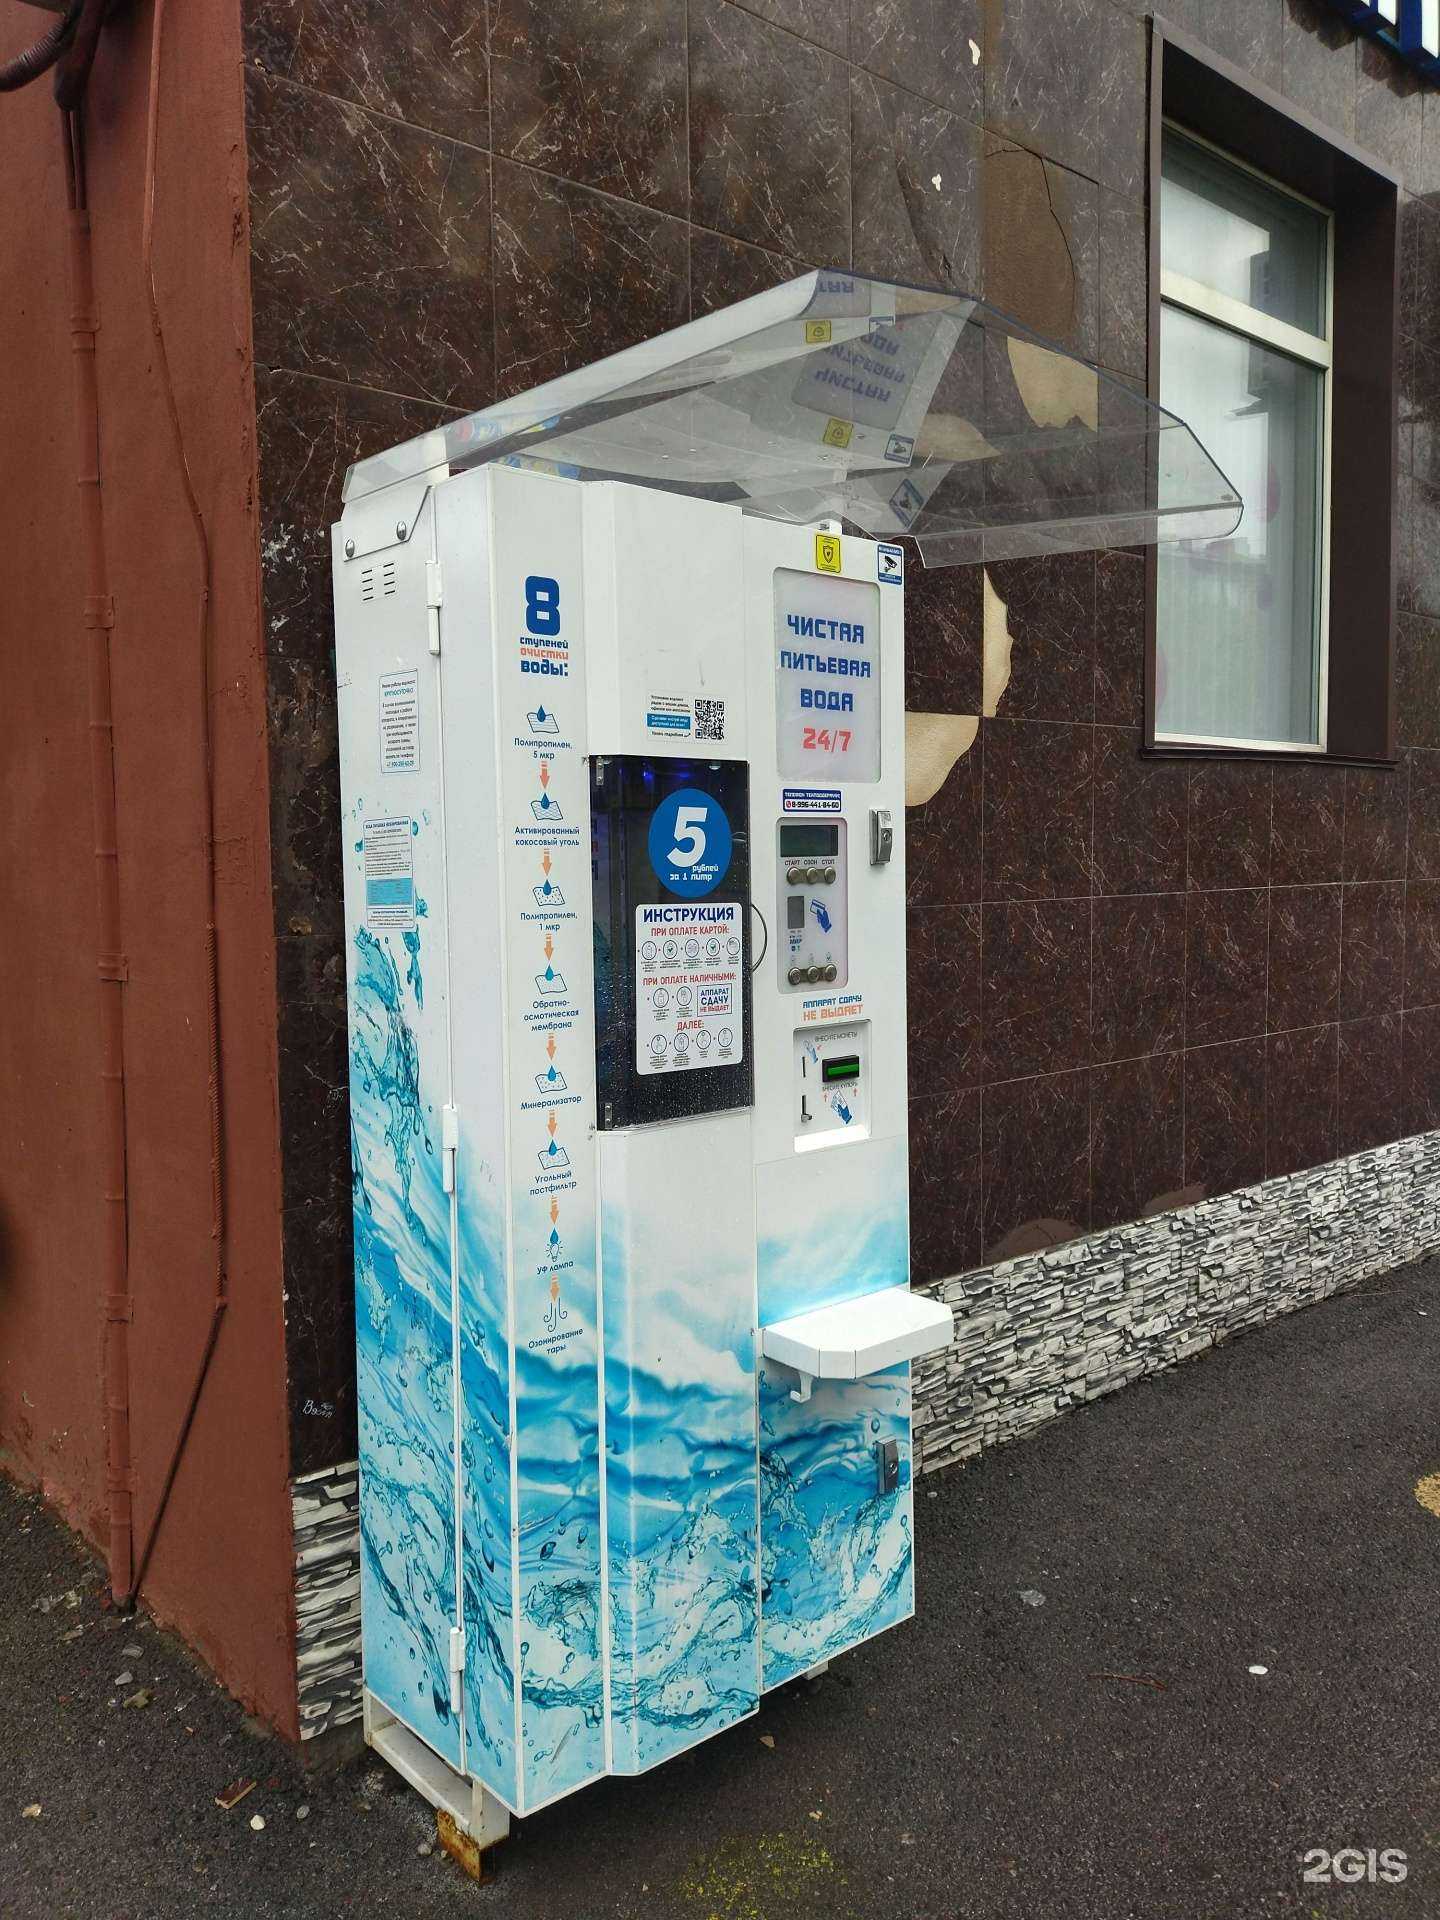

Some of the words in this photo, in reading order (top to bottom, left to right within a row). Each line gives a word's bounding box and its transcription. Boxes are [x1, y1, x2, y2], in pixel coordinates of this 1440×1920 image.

[525, 575, 560, 636] 8
[787, 614, 865, 644] ЧИСТАЯ
[520, 636, 569, 650] ступеней
[520, 647, 569, 660] очистки
[520, 658, 569, 676] воды:
[780, 650, 871, 678] ПИТЬЕВАЯ
[800, 687, 854, 712] ВОДА
[514, 738, 573, 749] Полипропилен,
[802, 727, 852, 753] 24/7
[539, 752, 555, 760] мкр
[514, 826, 580, 835] Активированный
[666, 806, 708, 867] 5
[515, 837, 558, 846] кокосовый
[559, 839, 580, 847] уголь
[692, 864, 719, 873] рублей
[690, 873, 713, 882] литр
[520, 912, 578, 922] Полипропилен,
[643, 906, 734, 923] ИНСТРУКЦИЯ
[539, 923, 543, 931] 1
[545, 924, 561, 932] мкр
[651, 927, 667, 937] ПРИ
[669, 925, 698, 936] ОПЛАТЕ
[699, 923, 730, 935] КАРТОЙ:
[642, 976, 658, 986] ПРИ
[660, 975, 687, 985] ОПЛАТЕ
[689, 973, 737, 983] НАЛИЧНЫМИ:
[700, 987, 729, 997] АППАРАТ
[532, 1000, 571, 1010] Обратно-
[701, 995, 729, 1006] СДАЧУ
[802, 997, 836, 1009] АППАРАТ
[838, 994, 863, 1004] СДАЧУ
[700, 1005, 707, 1013] НЕ
[707, 1004, 729, 1012] ВЫДАЕТ
[803, 1009, 817, 1021] НЕ
[820, 1004, 864, 1019] ВЫДАЕТ
[523, 1010, 579, 1021] осмотическая
[531, 1021, 573, 1032] мембрана
[676, 1020, 705, 1032] ДАЛЕЕ:
[520, 1095, 582, 1111] Минерализатор
[534, 1170, 572, 1184] Угольный
[530, 1181, 577, 1196] постфильтр
[536, 1265, 548, 1275] УФ
[549, 1260, 574, 1272] лампа
[528, 1328, 584, 1349] Озонирование
[546, 1344, 567, 1355] тары
